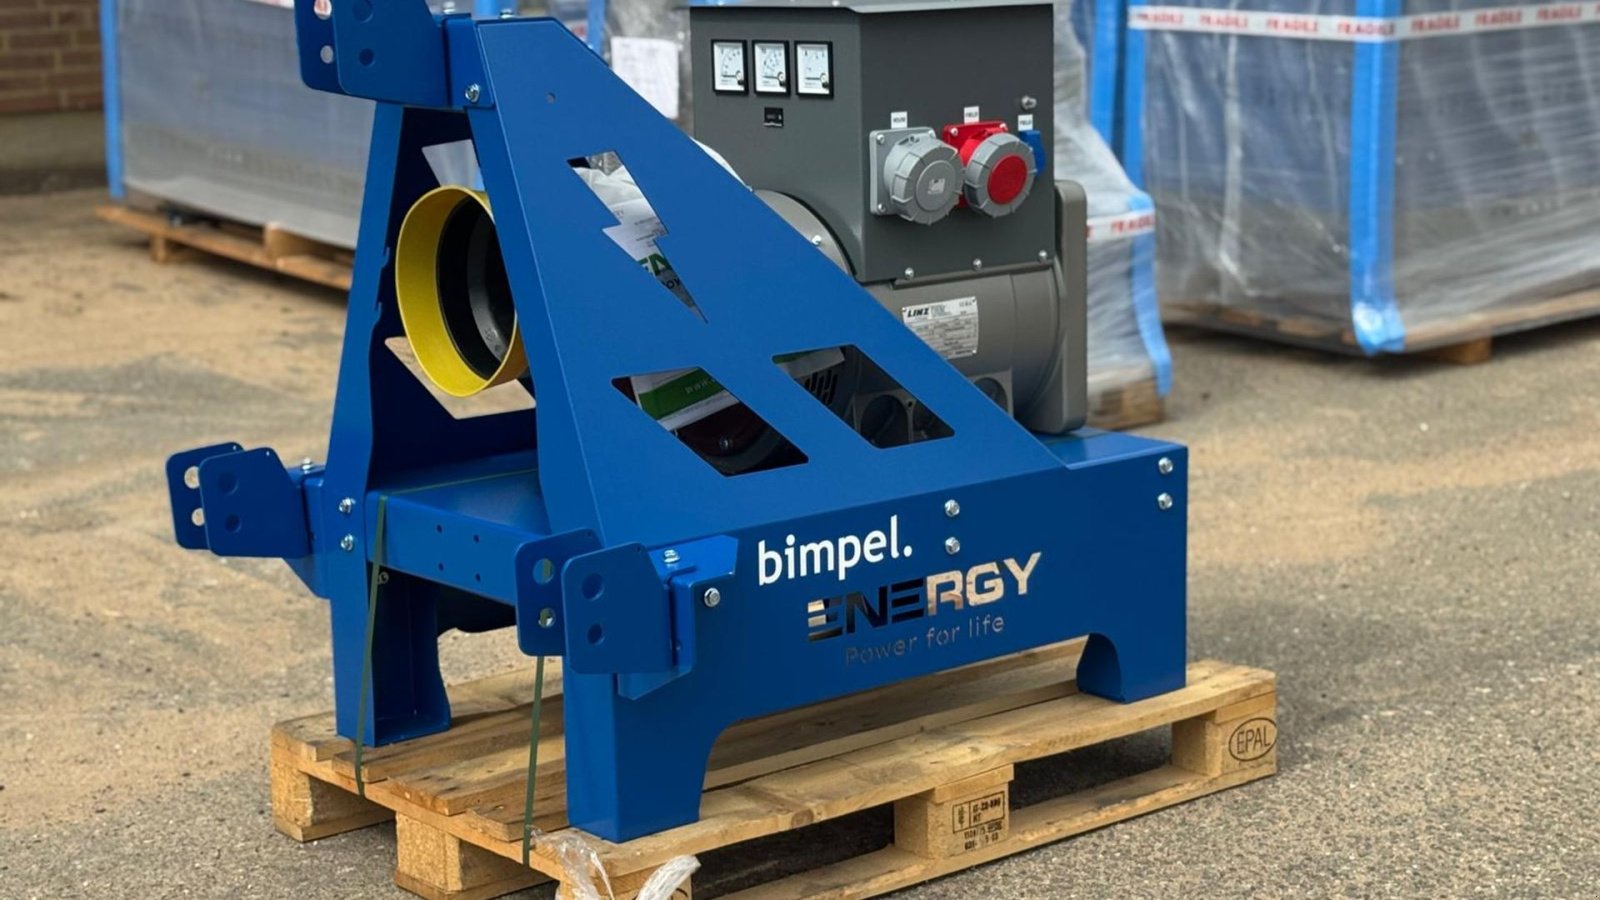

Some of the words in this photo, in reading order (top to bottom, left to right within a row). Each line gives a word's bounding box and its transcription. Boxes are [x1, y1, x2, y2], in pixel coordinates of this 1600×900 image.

[907, 307, 930, 318] LINZ
[758, 514, 913, 586] bimpel.
[808, 551, 1042, 643] ENERGY
[845, 635, 918, 667] Power
[926, 626, 961, 650] for
[968, 614, 1004, 639] life
[1236, 725, 1271, 755] EPAL
